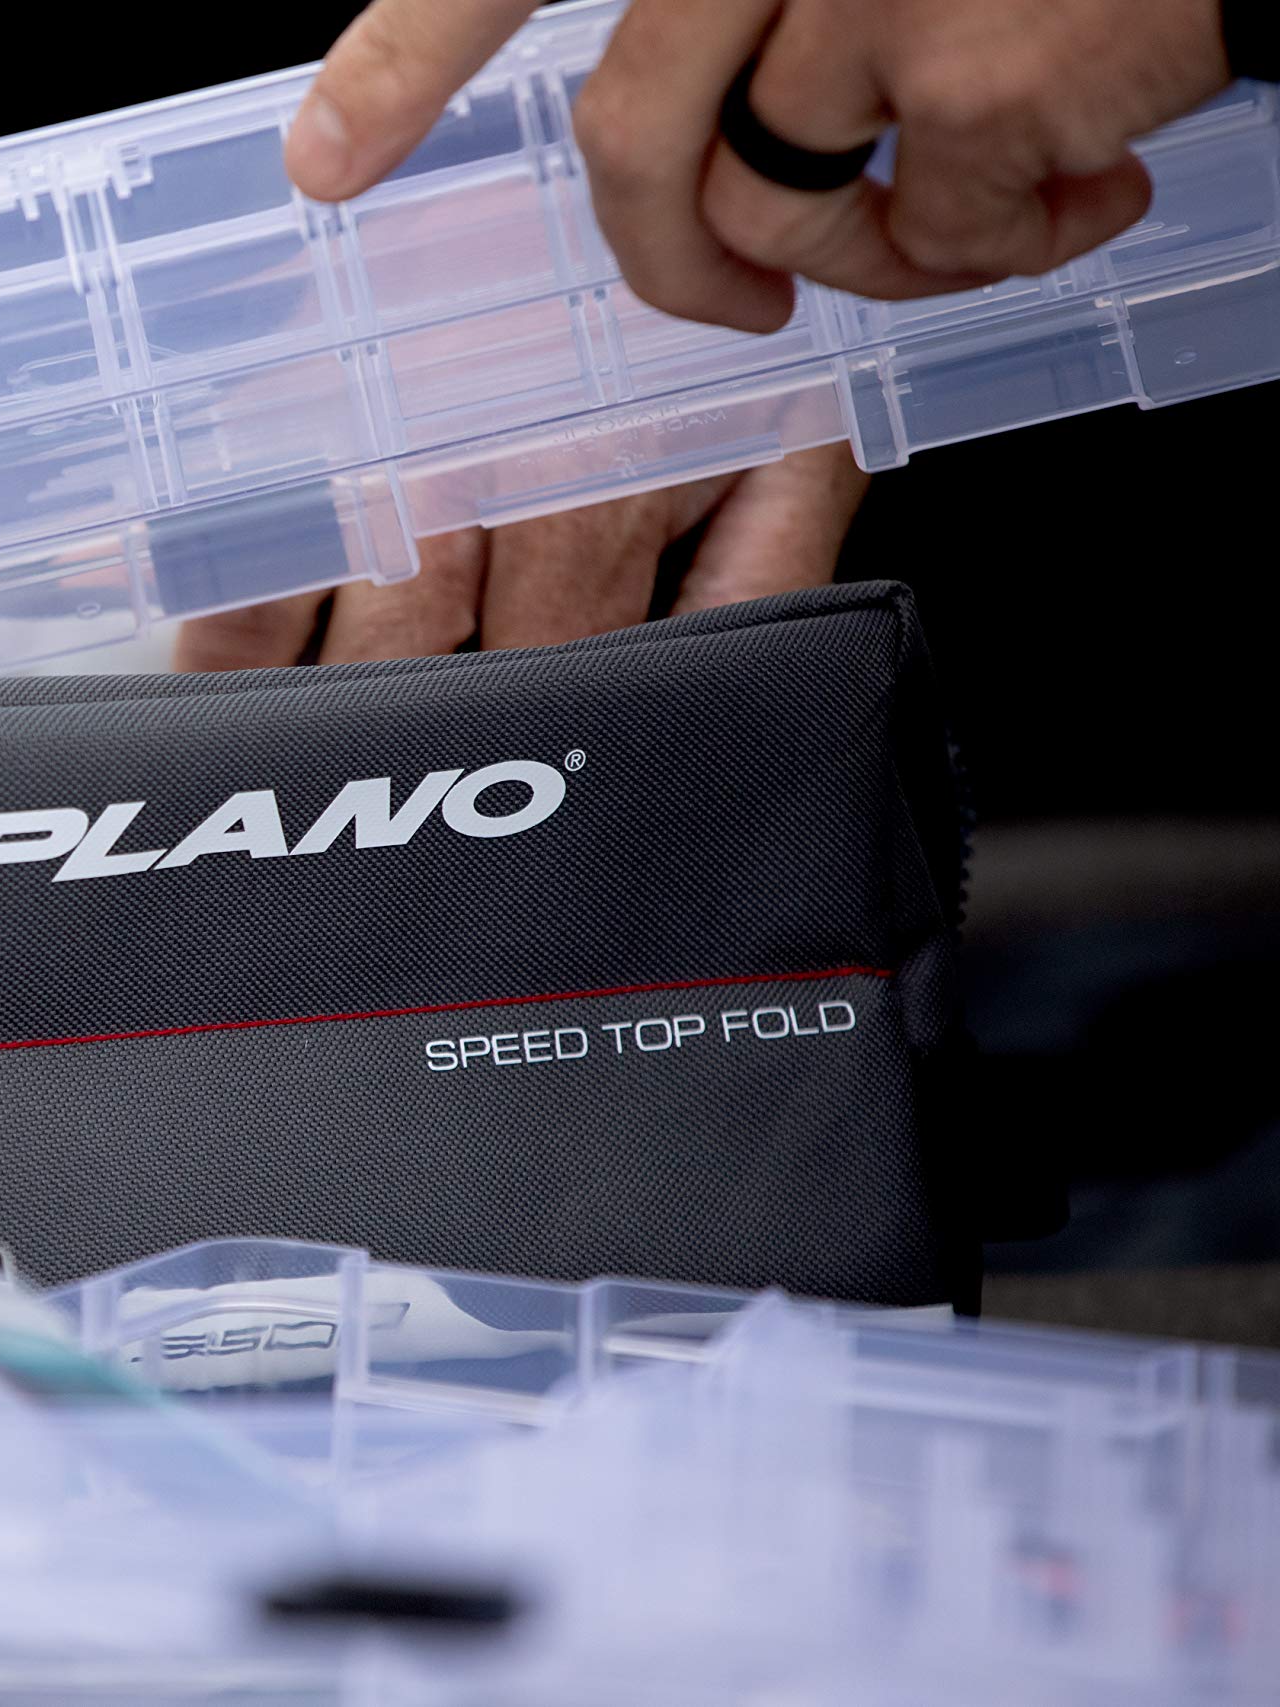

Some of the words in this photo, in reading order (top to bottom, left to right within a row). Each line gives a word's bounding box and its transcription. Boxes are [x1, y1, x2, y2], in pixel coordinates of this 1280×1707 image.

[425, 1027, 588, 1071] SPEED
[601, 1015, 706, 1054] TOP
[721, 1001, 856, 1043] FOLD
